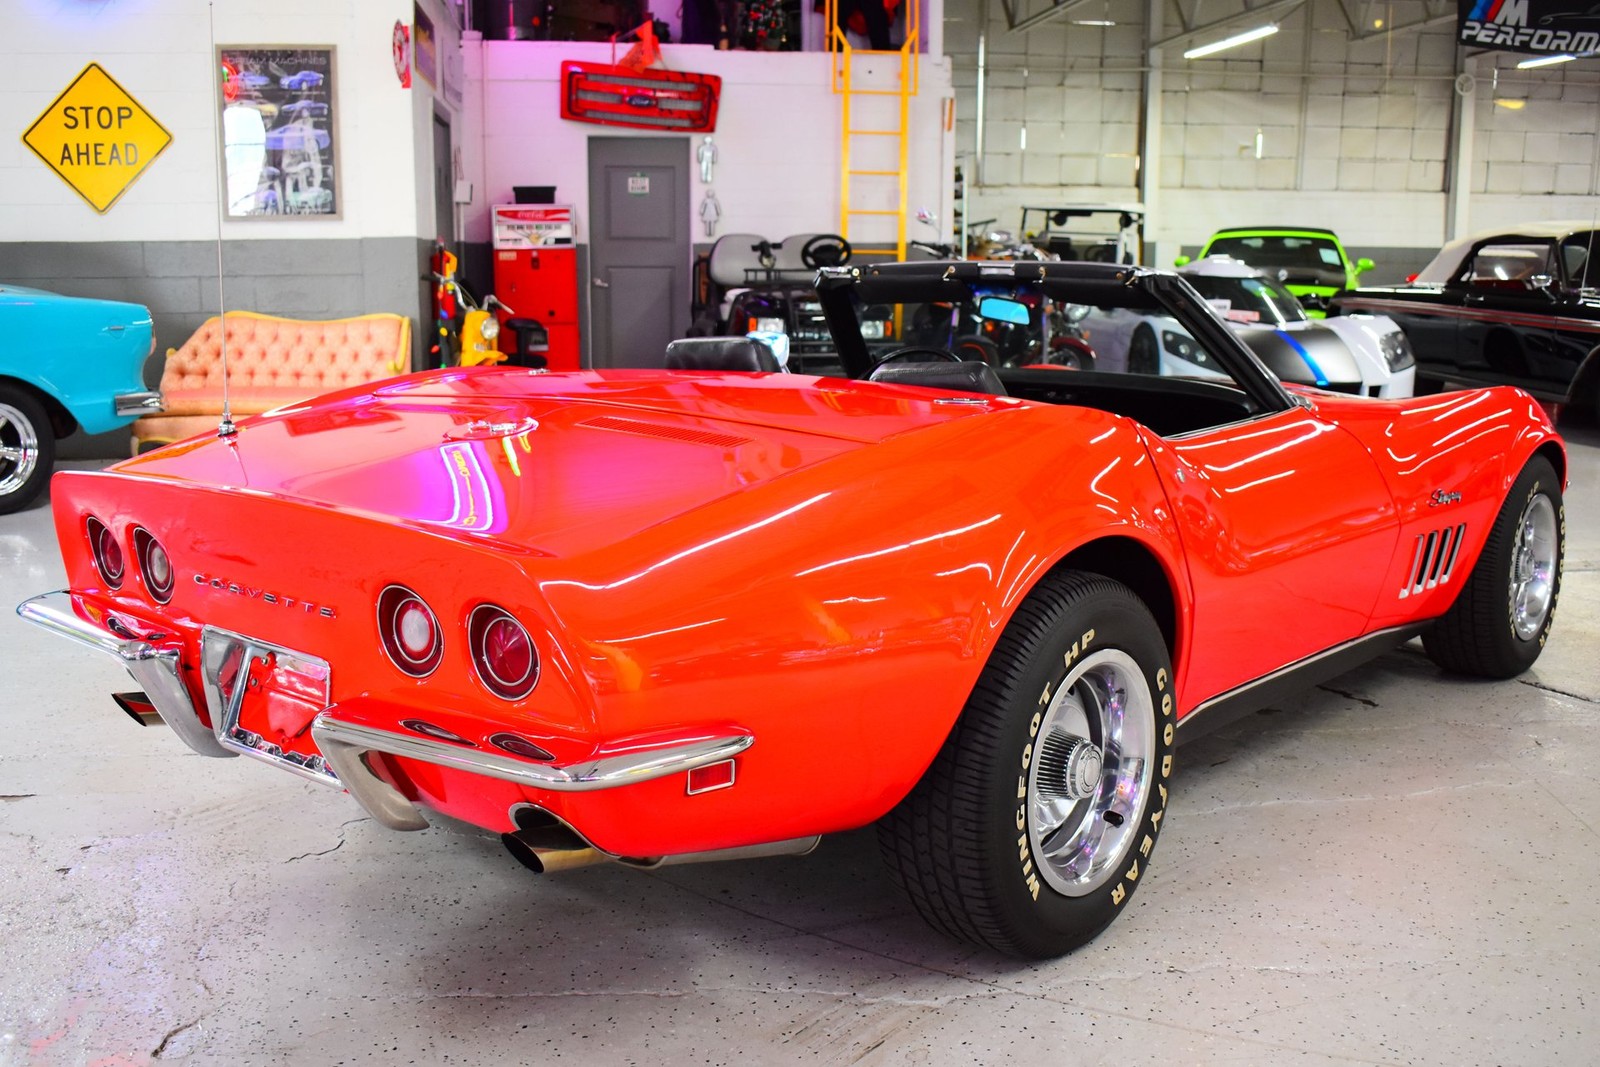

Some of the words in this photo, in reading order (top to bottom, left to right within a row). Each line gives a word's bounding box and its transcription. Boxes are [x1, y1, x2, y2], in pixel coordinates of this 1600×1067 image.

[1461, 21, 1600, 53] PERFORM
[269, 57, 327, 66] MACHINES
[63, 106, 133, 129] STOP
[60, 143, 138, 166] AHEAD
[193, 573, 337, 619] CORVETTE
[1016, 681, 1051, 901] WINGFOOT
[1064, 628, 1095, 668] HP
[1111, 667, 1174, 905] GOODYEAR
